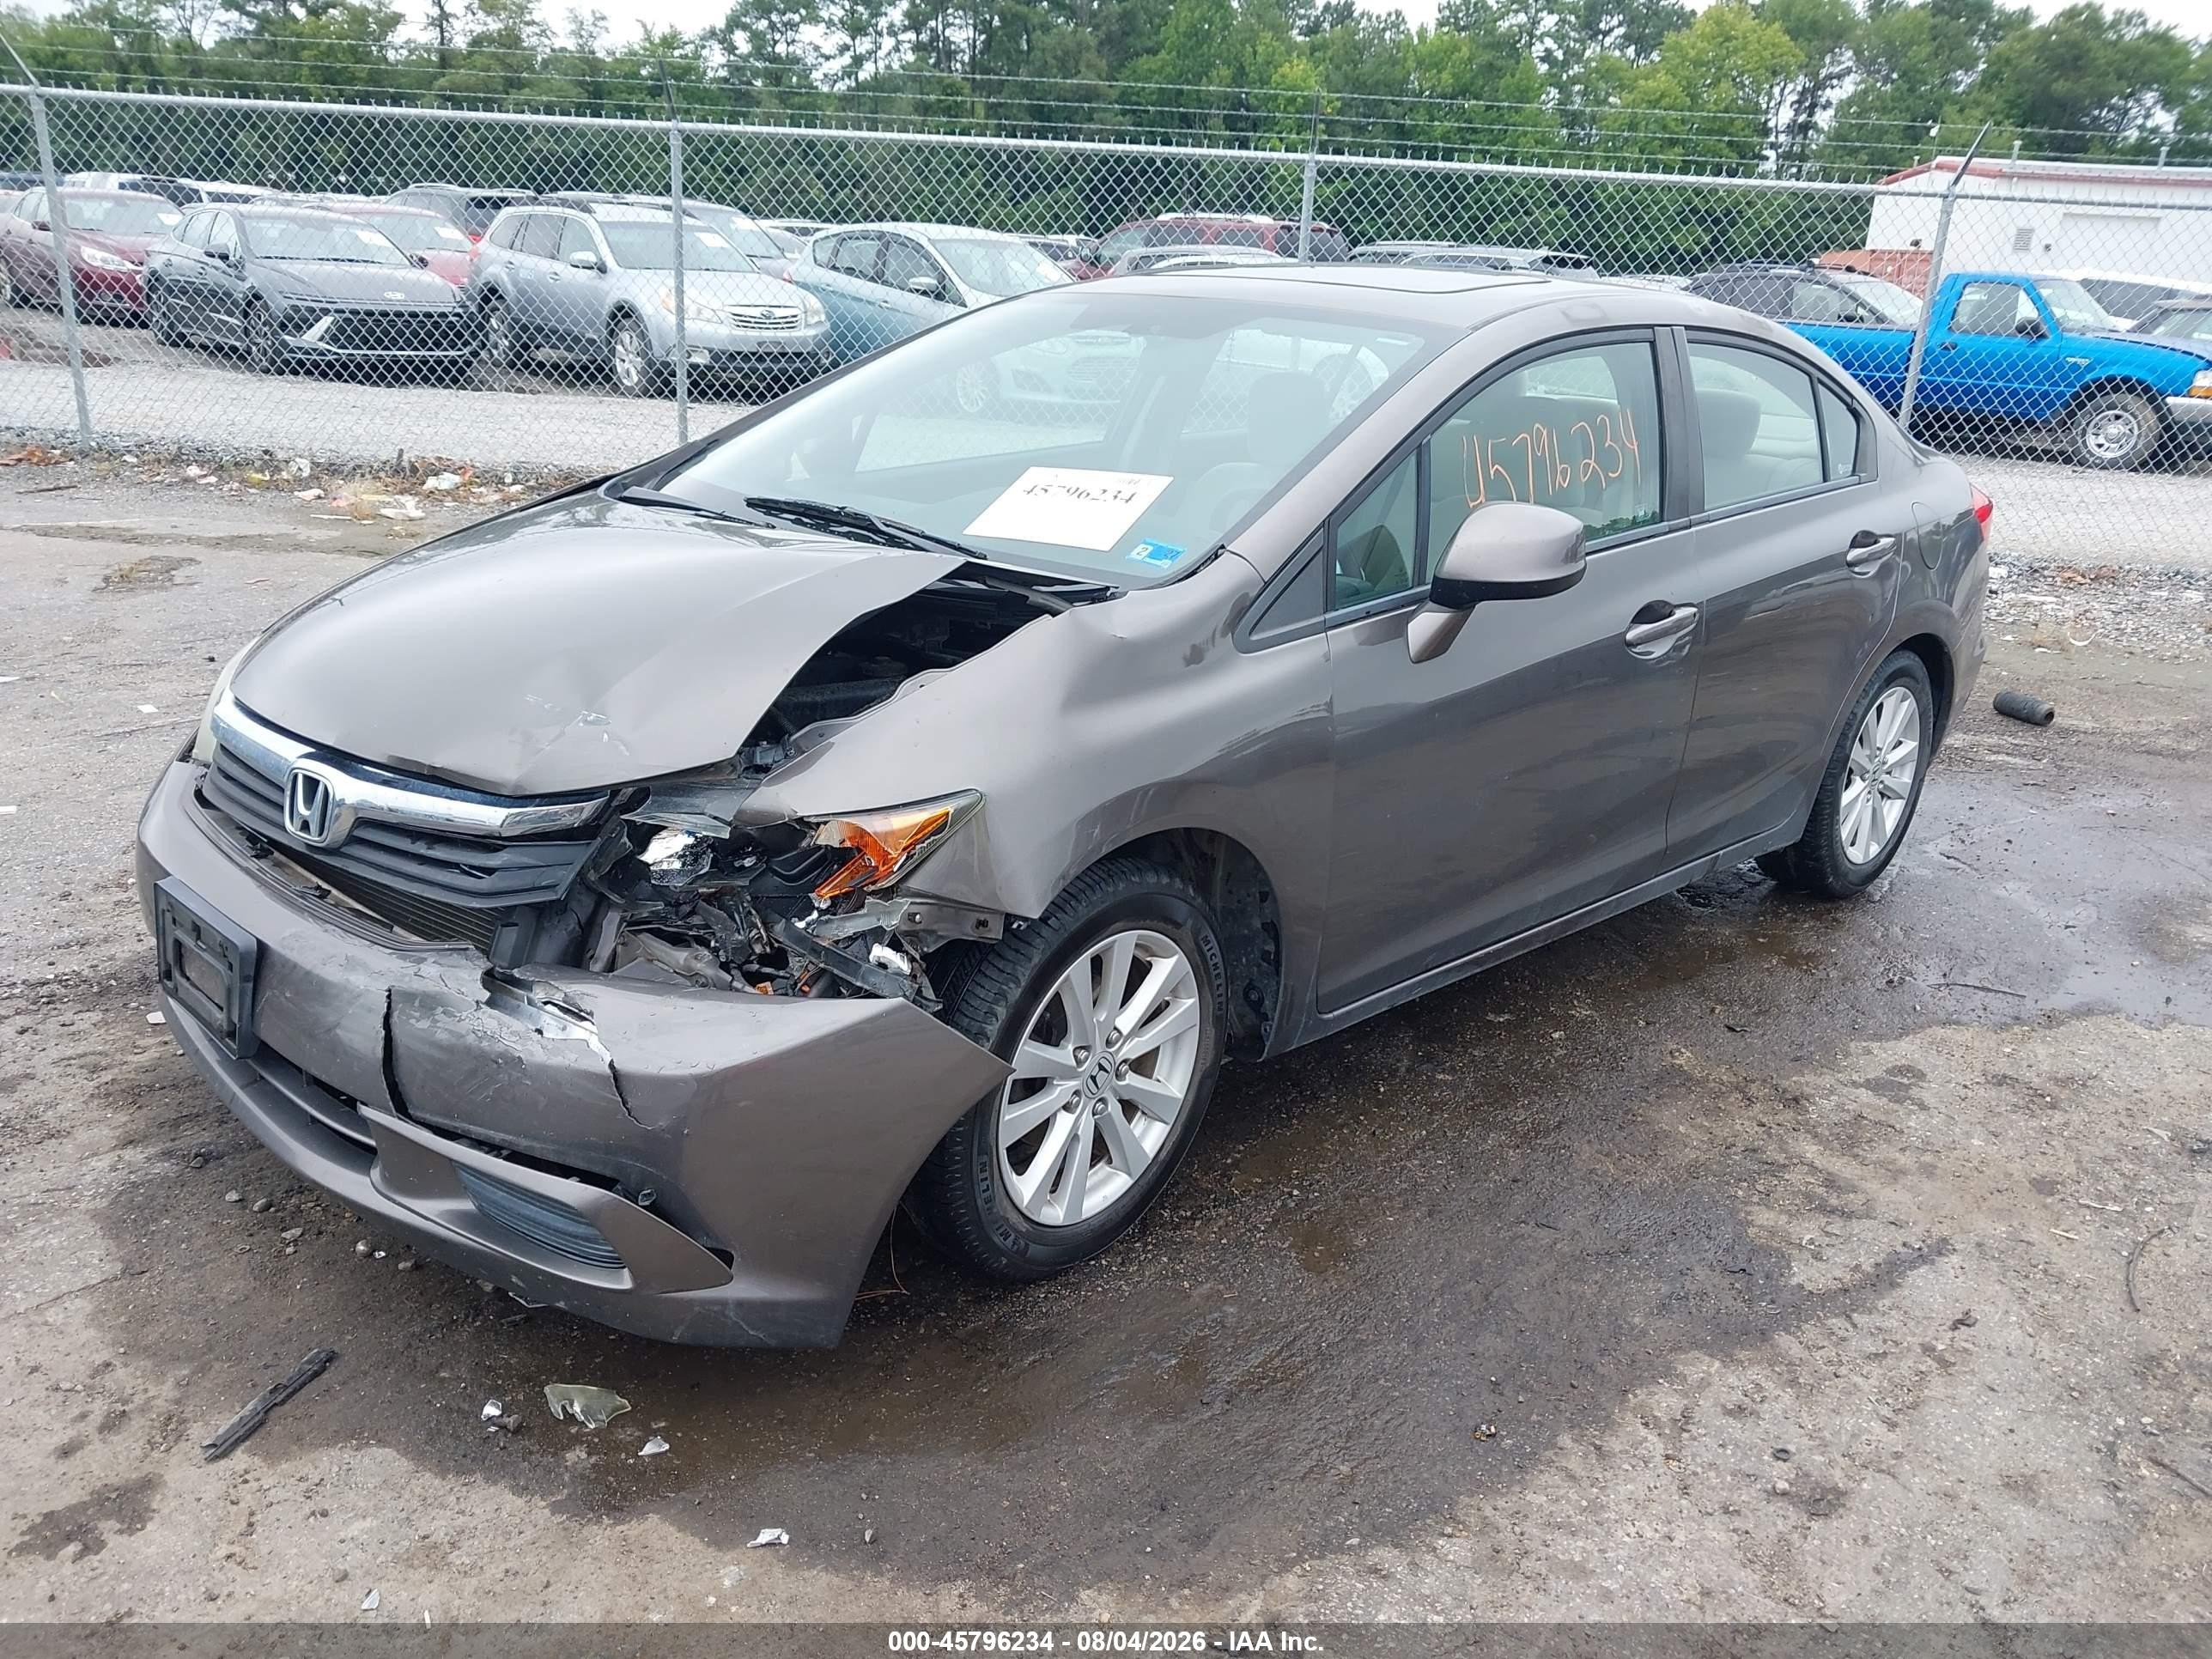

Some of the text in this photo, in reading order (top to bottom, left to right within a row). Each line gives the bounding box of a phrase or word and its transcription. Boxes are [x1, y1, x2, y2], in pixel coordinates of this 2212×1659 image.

[1136, 546, 1149, 556] 2
[1200, 933, 1224, 1012] MICHELIN
[979, 1160, 1012, 1243] MIELIN
